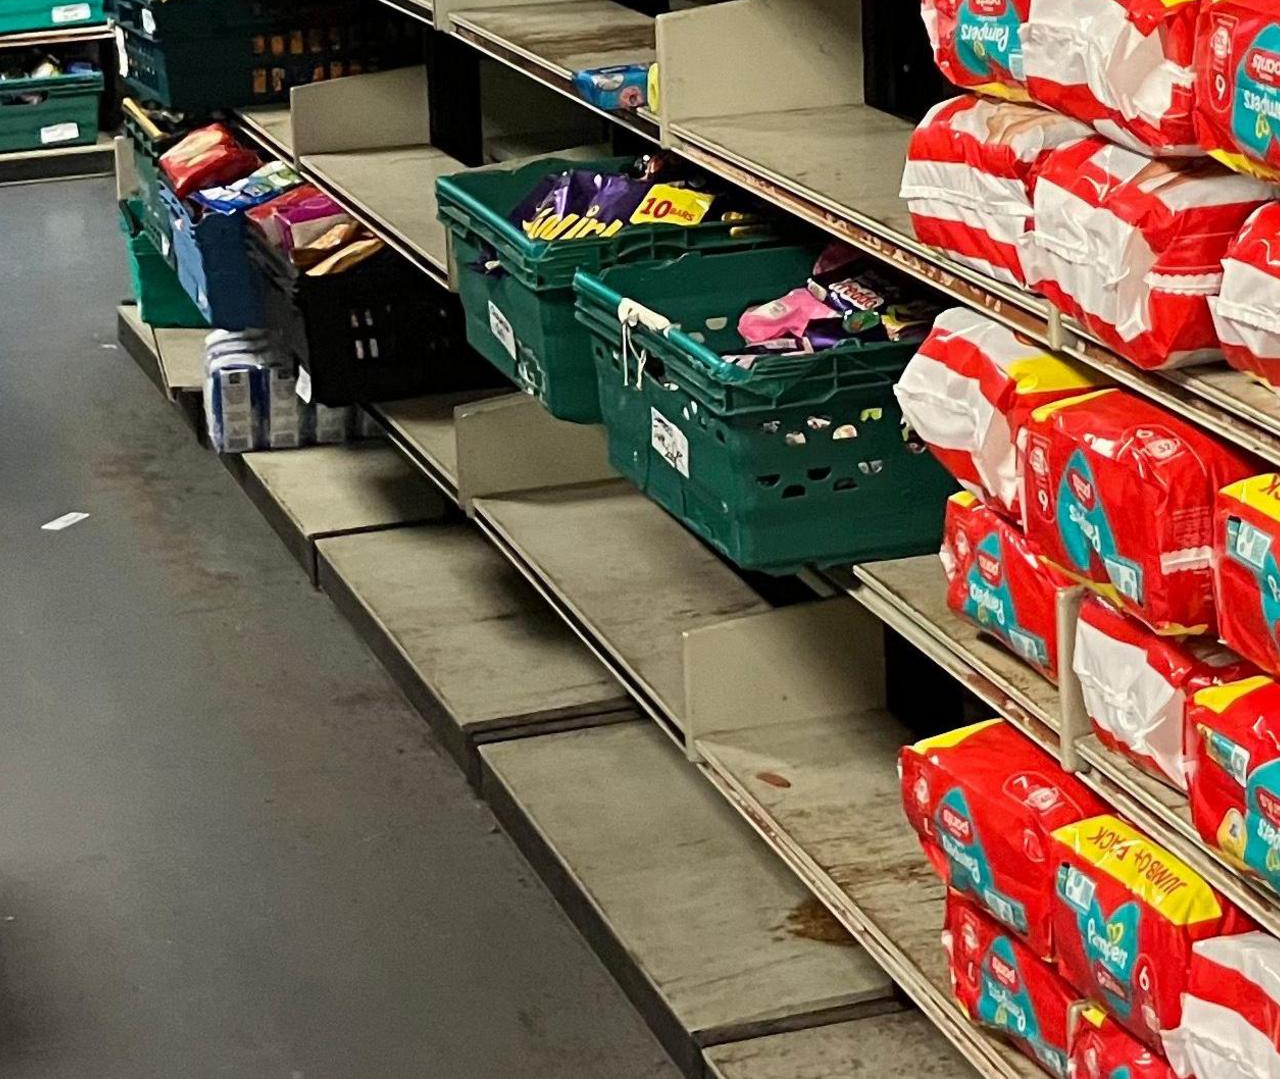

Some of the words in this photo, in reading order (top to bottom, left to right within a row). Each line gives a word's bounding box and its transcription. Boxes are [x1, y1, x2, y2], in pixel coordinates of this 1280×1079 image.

[960, 23, 1009, 53] Pampers
[640, 197, 673, 219] 10
[669, 207, 696, 221] BARS
[1134, 851, 1188, 895] JUMBO+
[1138, 965, 1151, 992] 6
